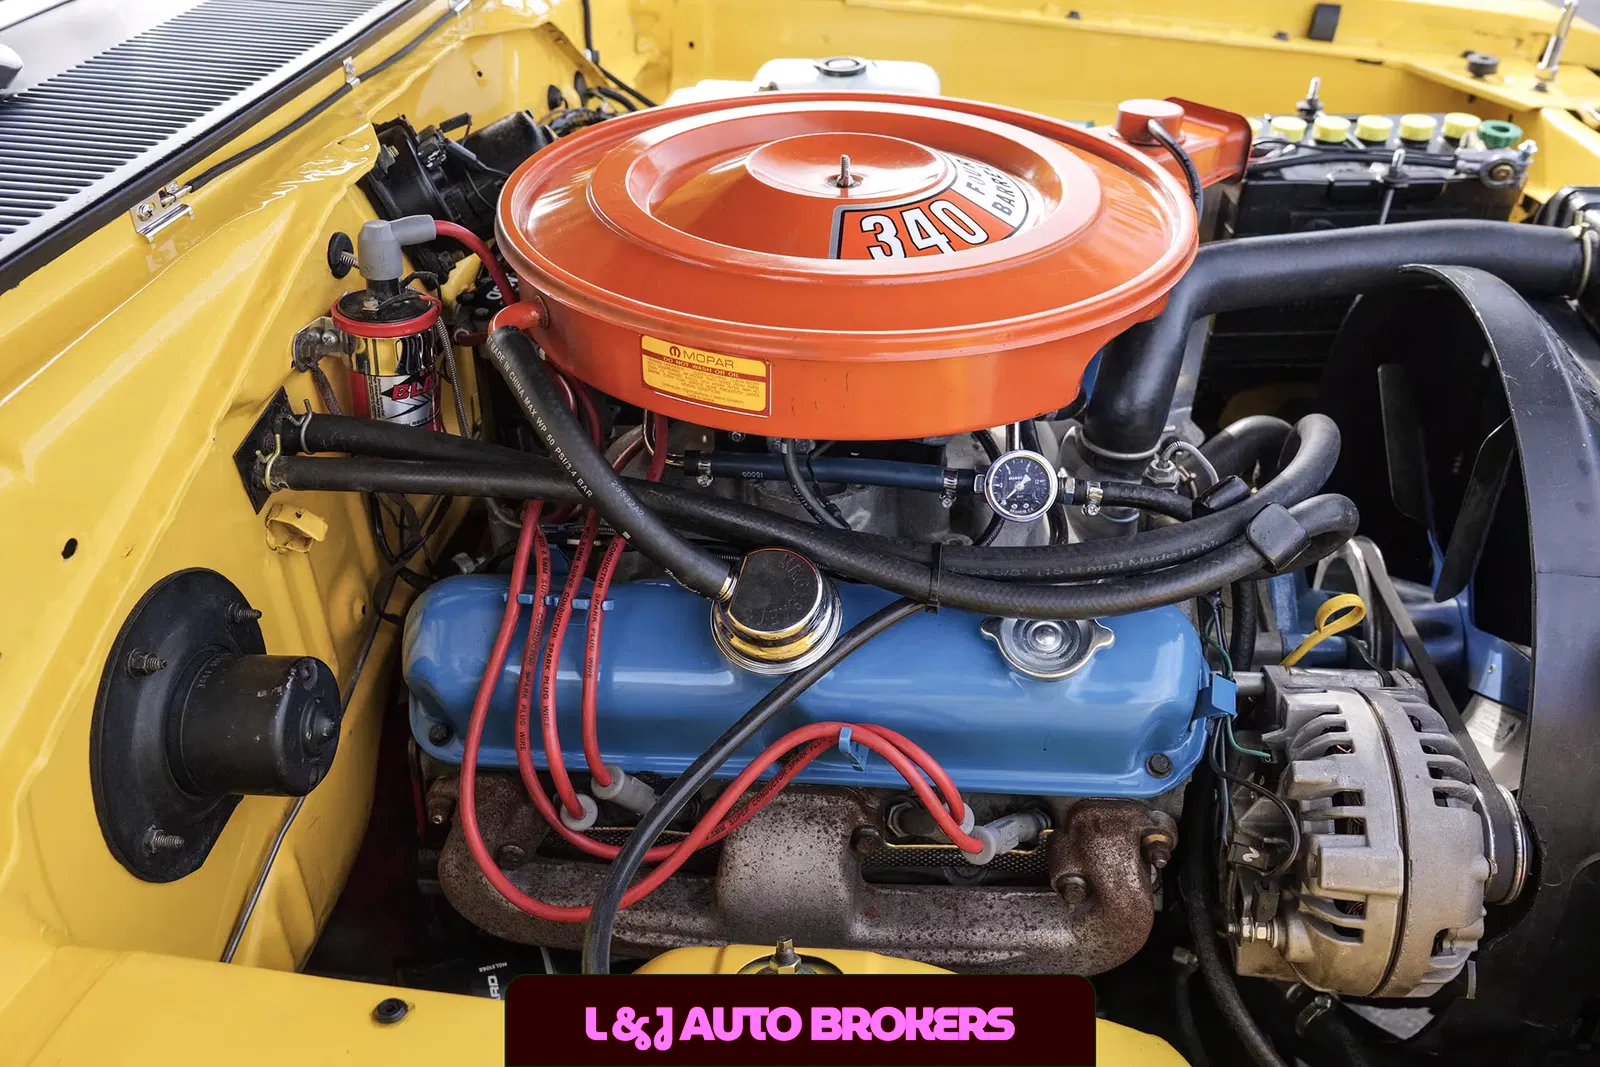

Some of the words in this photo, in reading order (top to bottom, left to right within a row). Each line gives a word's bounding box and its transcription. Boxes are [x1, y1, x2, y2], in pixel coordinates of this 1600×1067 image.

[860, 199, 989, 259] 340
[675, 360, 690, 368] NOT
[692, 363, 713, 373] WASH
[683, 350, 734, 369] MOPAR
[490, 344, 506, 363] MADE
[503, 360, 511, 372] IN
[508, 371, 526, 399] CHINA
[523, 397, 538, 417] MAX
[536, 416, 548, 434] WP
[545, 433, 556, 446] 50
[554, 446, 578, 478] PSI/3.4
[576, 478, 594, 498] BAR
[567, 565, 579, 588] SUPER
[596, 542, 619, 589] CONDUCTOR
[538, 579, 547, 608] SUPER
[591, 593, 601, 623] SPARK
[551, 592, 571, 639] CONDUCTOR
[527, 608, 545, 666] CONDUCTOR
[589, 628, 597, 652] PLUG
[544, 642, 555, 671] SPARK
[587, 658, 595, 680] WIRE
[521, 670, 532, 699] SPARK
[519, 704, 527, 727] PLUG
[519, 731, 527, 752] WIRE
[728, 807, 750, 825] SUPER
[752, 769, 787, 806] CONDUCTOR
[789, 750, 808, 770] SPARK
